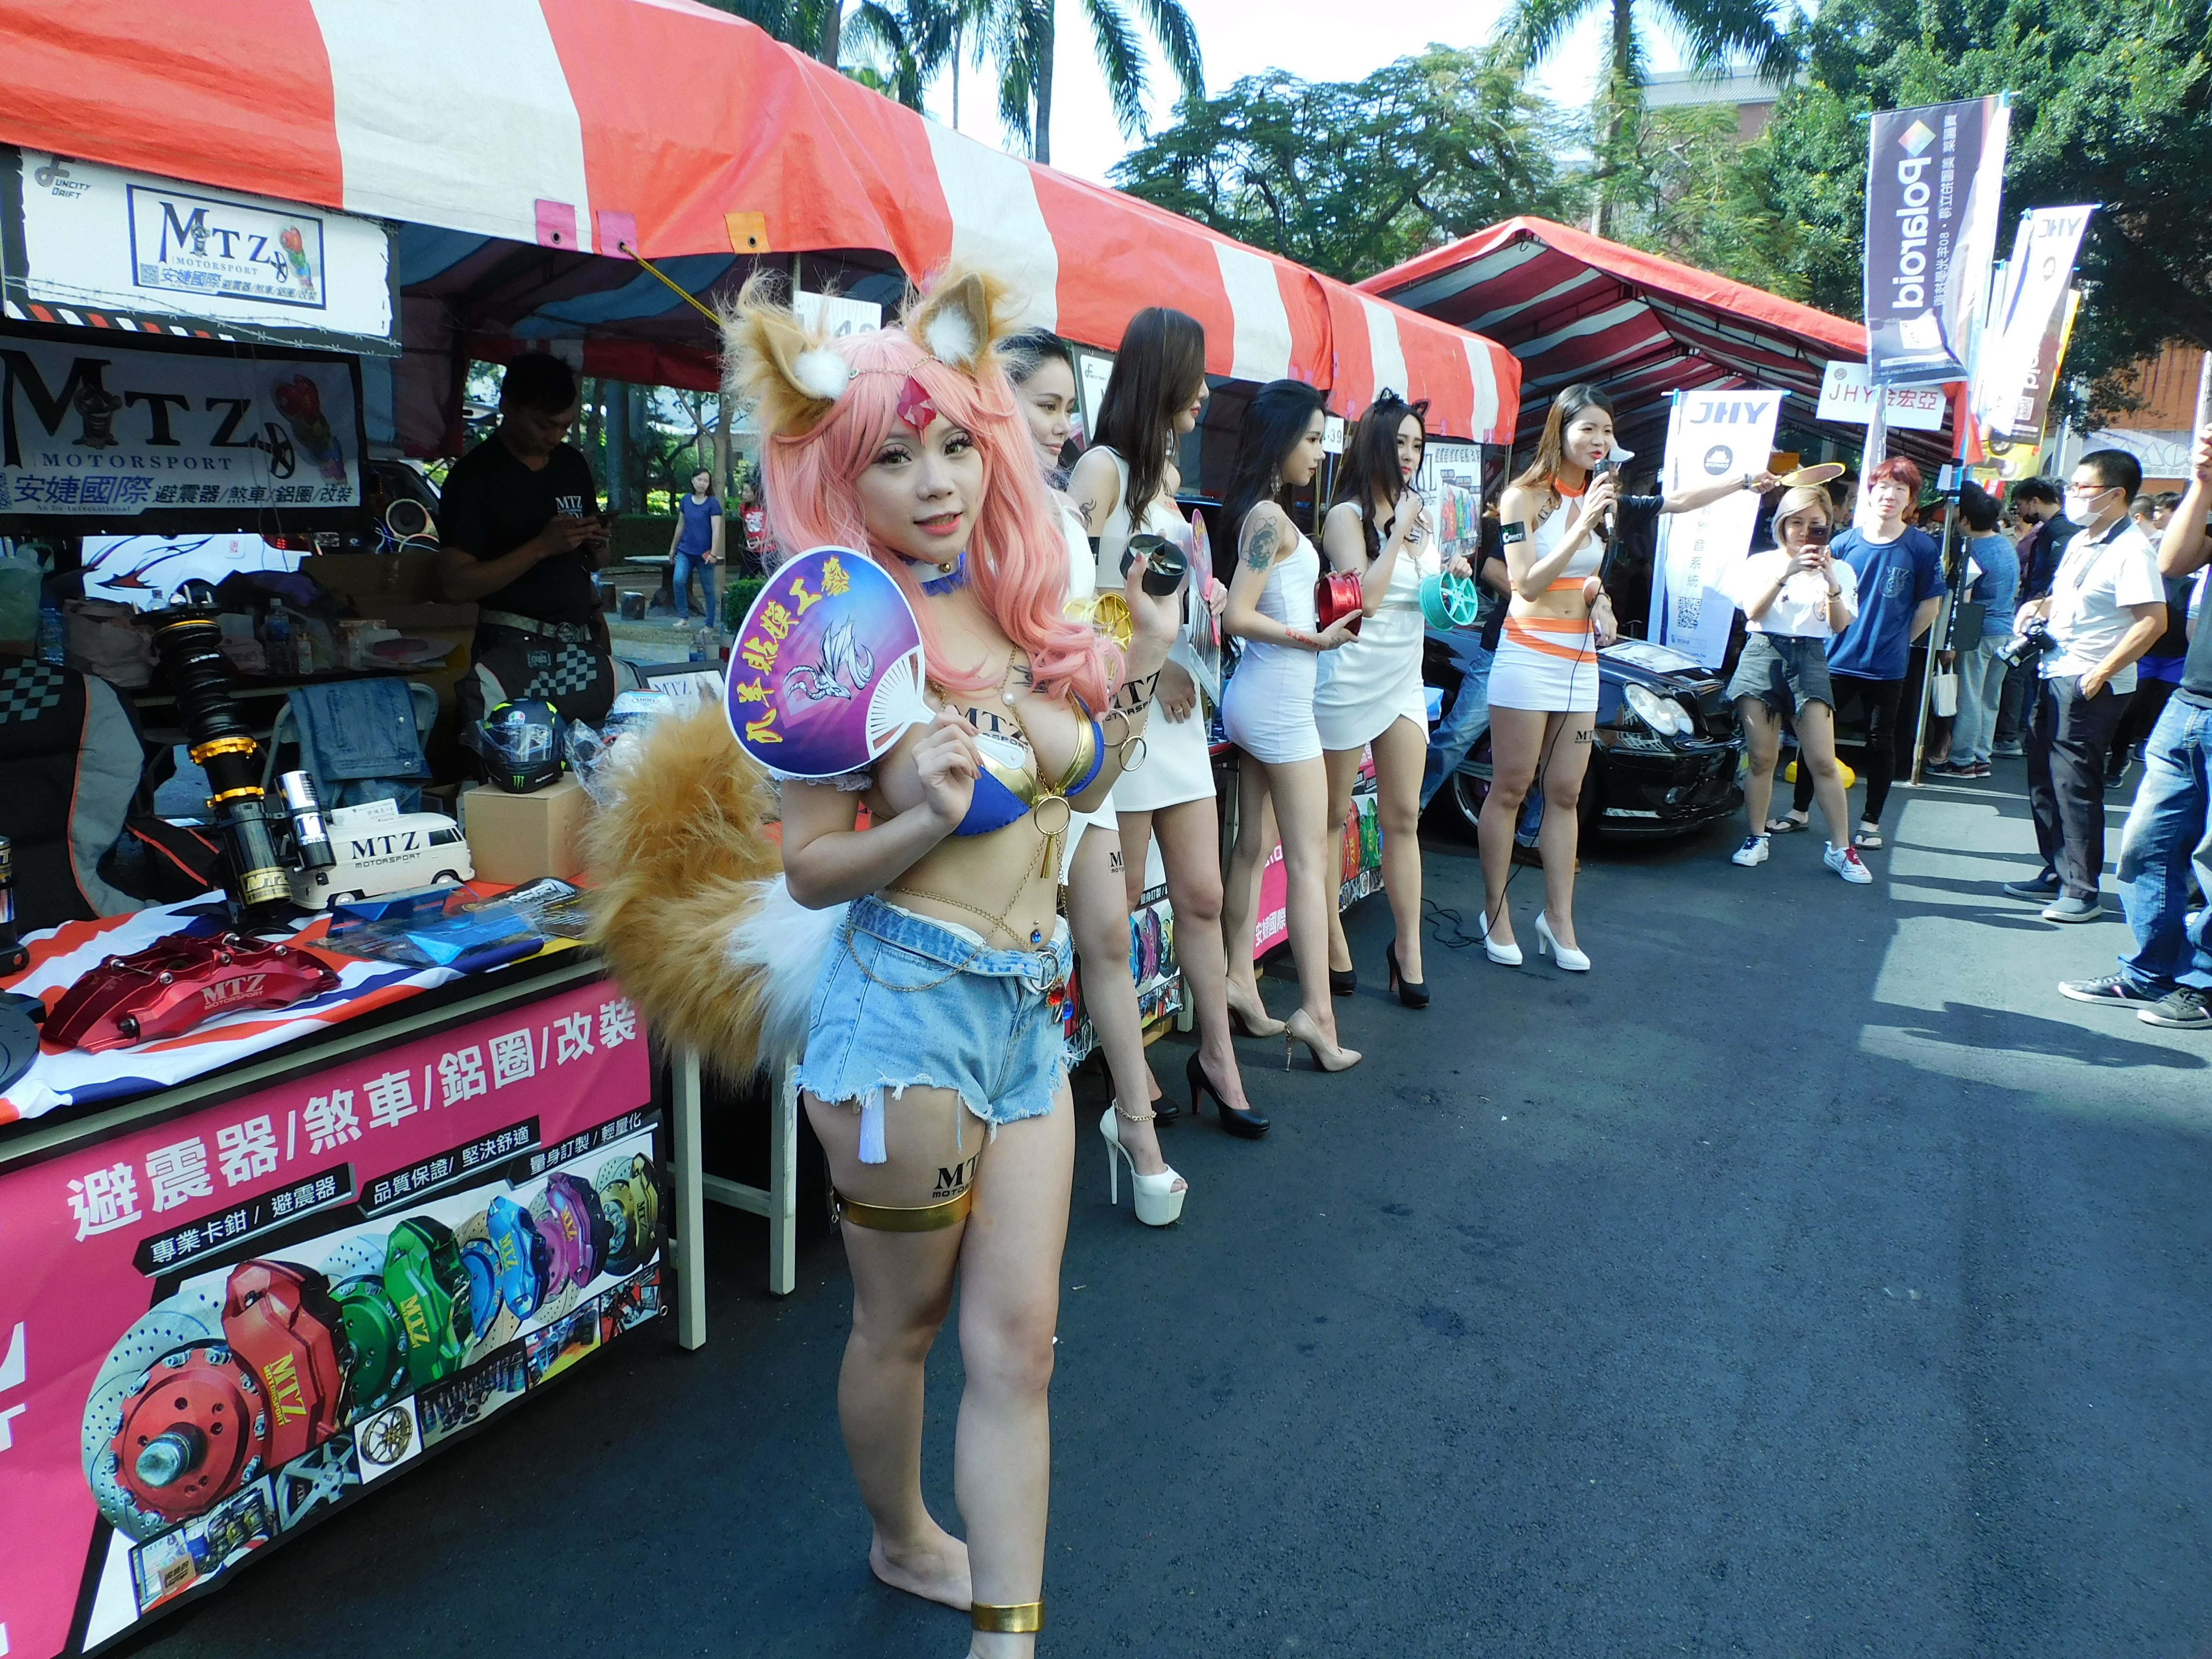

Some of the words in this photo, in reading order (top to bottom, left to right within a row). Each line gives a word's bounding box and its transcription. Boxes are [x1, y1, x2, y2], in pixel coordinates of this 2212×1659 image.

[158, 201, 271, 264] MTZ
[160, 267, 222, 288] 安婕國際
[177, 257, 258, 275] MOTORSPORT
[0, 349, 255, 469] MTZ
[1829, 384, 1873, 404] JHY
[1690, 402, 1770, 424] JHY
[41, 452, 233, 470] MOTORSPORT
[14, 474, 155, 504] 安婕國際
[555, 495, 582, 510] MTZ
[1575, 730, 1594, 740] MT
[351, 831, 420, 860] MTZ
[355, 853, 421, 868] MOTORSPORT
[1109, 851, 1122, 867] M
[1256, 907, 1286, 948] 安婕國際
[201, 974, 266, 1005] MTZ
[204, 991, 264, 1010] MOTORSPORT
[462, 1125, 529, 1168] 堅決舒適
[529, 1133, 589, 1176] 量身訂製
[601, 1112, 641, 1143] 輕量化
[934, 1151, 980, 1190] MT
[150, 1209, 248, 1264] 專業卡鉗
[271, 1175, 336, 1219] 避震器
[561, 1206, 577, 1242] MTZ
[499, 1232, 518, 1272] MTZ
[402, 1294, 431, 1345] MTZ
[263, 1364, 285, 1427] MOTORSPORT
[270, 1350, 307, 1424] MTZ
